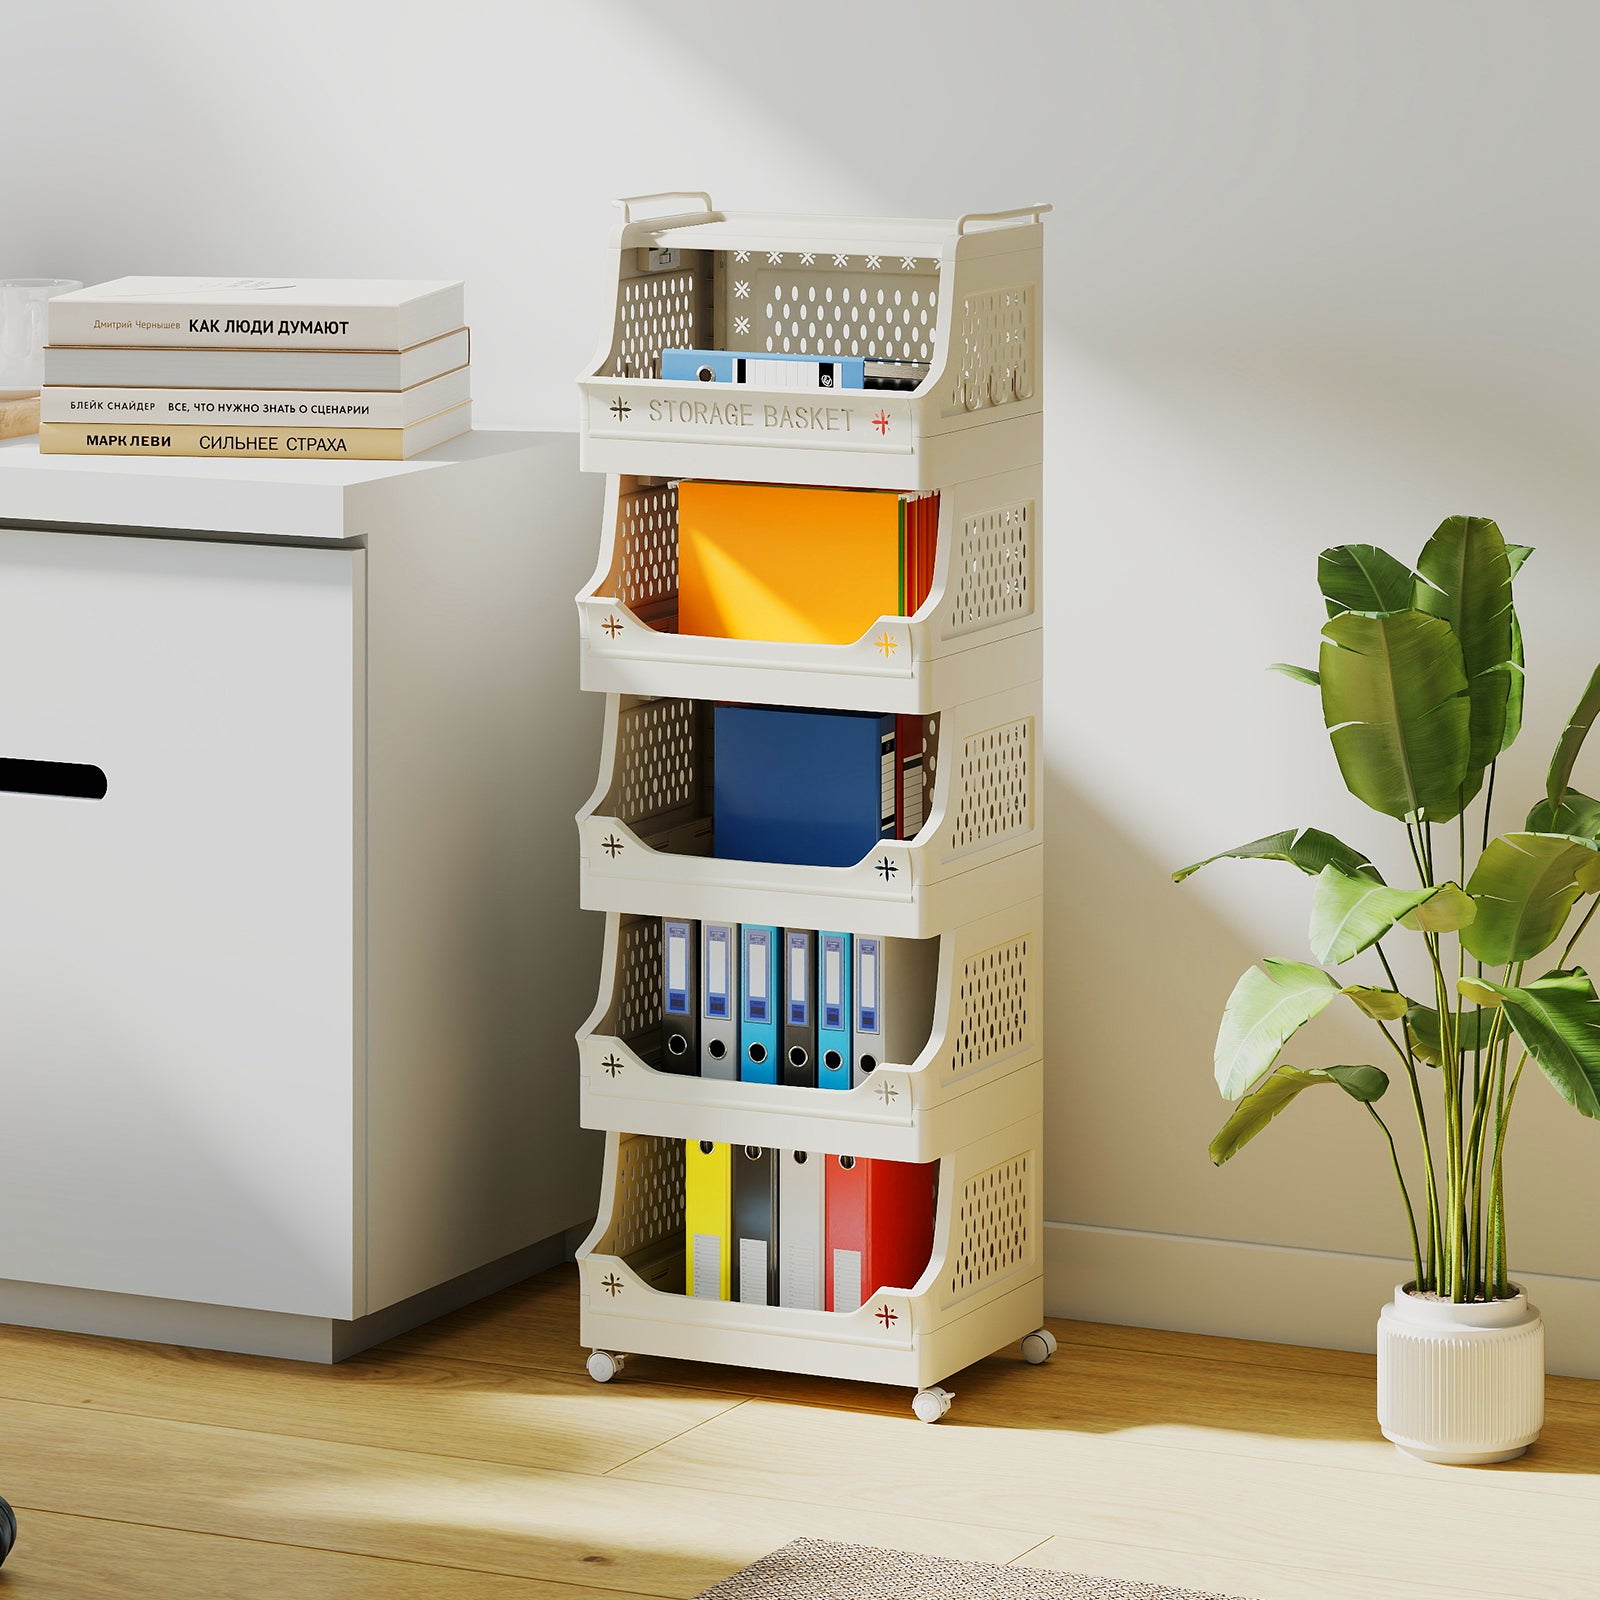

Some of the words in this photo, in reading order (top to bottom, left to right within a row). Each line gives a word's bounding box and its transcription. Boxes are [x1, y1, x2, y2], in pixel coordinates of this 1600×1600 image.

[93, 319, 132, 331] Дмитрий
[135, 320, 181, 331] Чернышев
[189, 318, 220, 333] КАК
[224, 319, 274, 336] ЛЮДИ
[277, 320, 350, 337] ДУМАЮТ
[70, 399, 104, 411] БЛЕЙК
[107, 400, 156, 413] СНАЙДЕР
[168, 402, 190, 414] ВСЕ,
[193, 402, 215, 413] ЧТО
[218, 403, 260, 414] НУЖНО
[263, 403, 296, 414] ЗНАТЬ
[299, 404, 308, 414] О
[310, 404, 370, 416] СЦЕНАРИИ
[648, 398, 754, 427] STORAGE
[763, 403, 855, 432] BASKET
[86, 434, 127, 447] МАРК
[129, 435, 171, 448] ЛЕВИ
[199, 435, 279, 451] СИЛЬНЕЕ
[286, 436, 348, 452] СТРАХА
